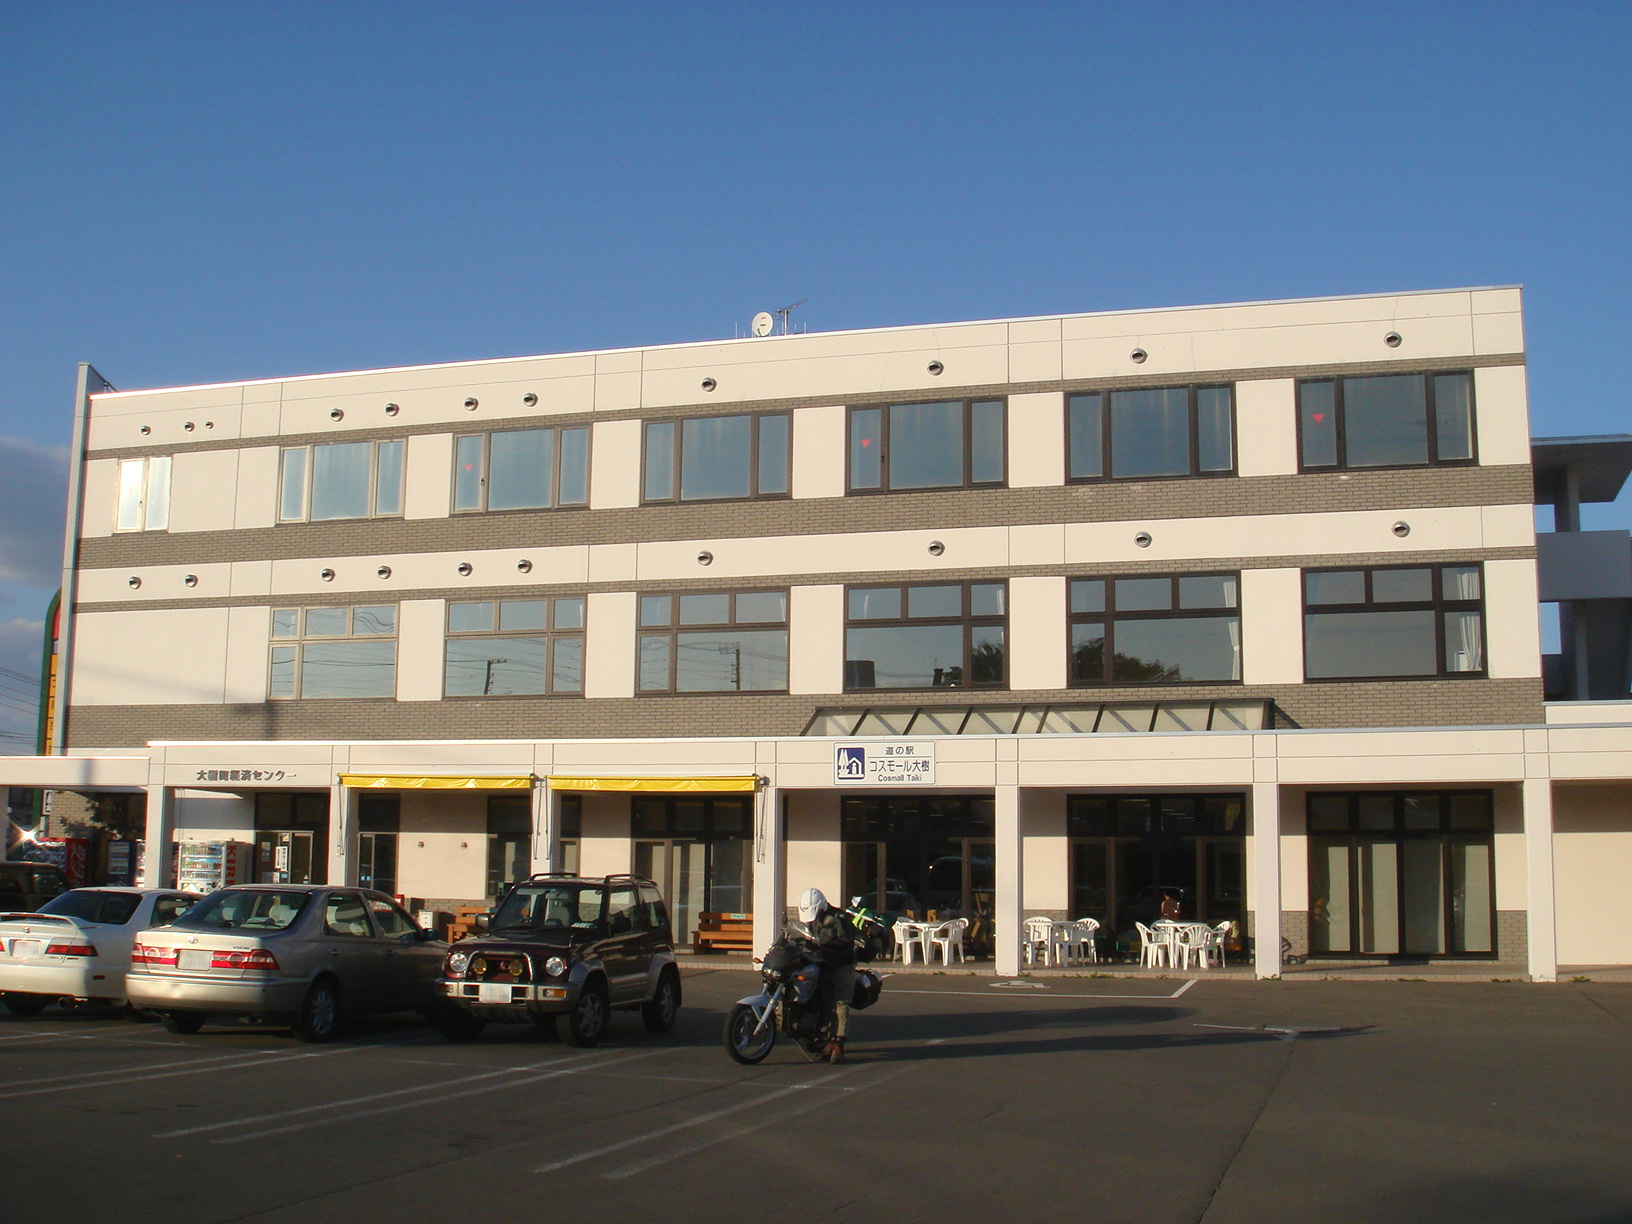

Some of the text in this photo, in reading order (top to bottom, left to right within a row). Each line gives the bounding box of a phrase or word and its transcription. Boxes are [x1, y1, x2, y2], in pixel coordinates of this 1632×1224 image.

[885, 746, 914, 755] 道の駅
[869, 760, 930, 772] コスモール大樹
[877, 774, 904, 782] Cosmall
